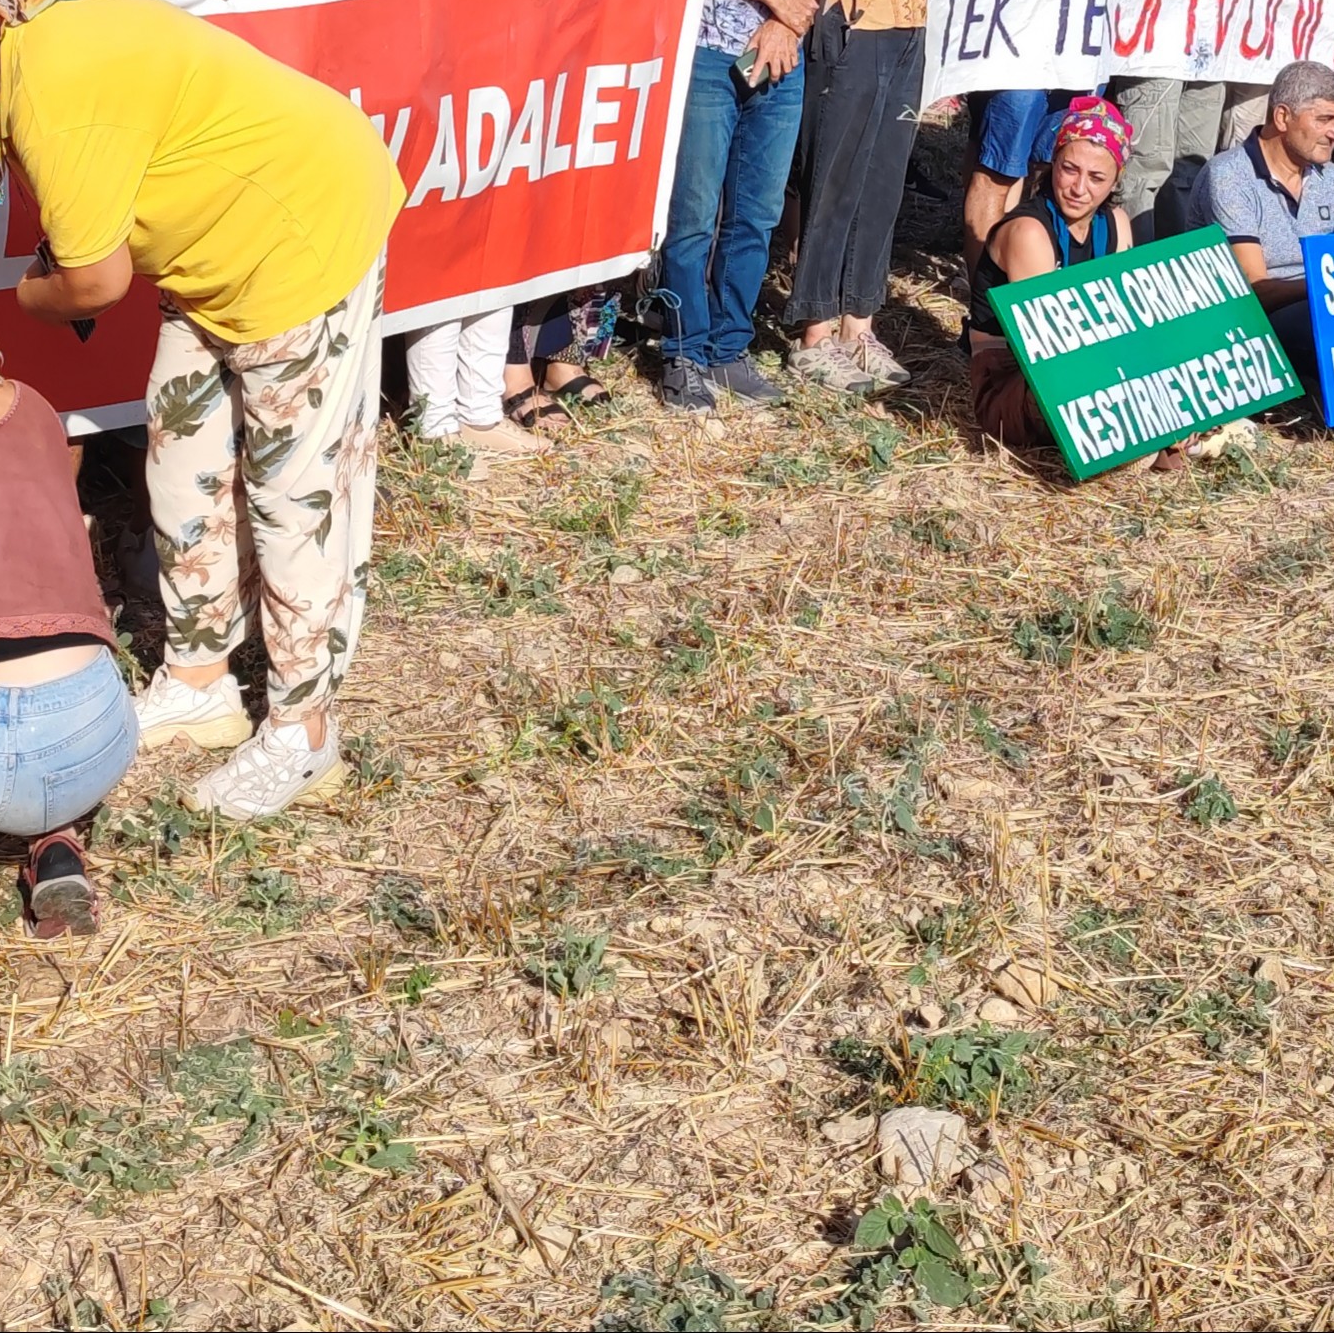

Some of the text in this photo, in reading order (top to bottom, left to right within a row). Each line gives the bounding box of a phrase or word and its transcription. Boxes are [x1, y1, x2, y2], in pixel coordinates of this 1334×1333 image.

[404, 57, 663, 209] ADALET
[1010, 242, 1251, 364] AKBELEN ORMANI'NI
[1057, 326, 1284, 464] KESTİRMEYECEĞİZ
